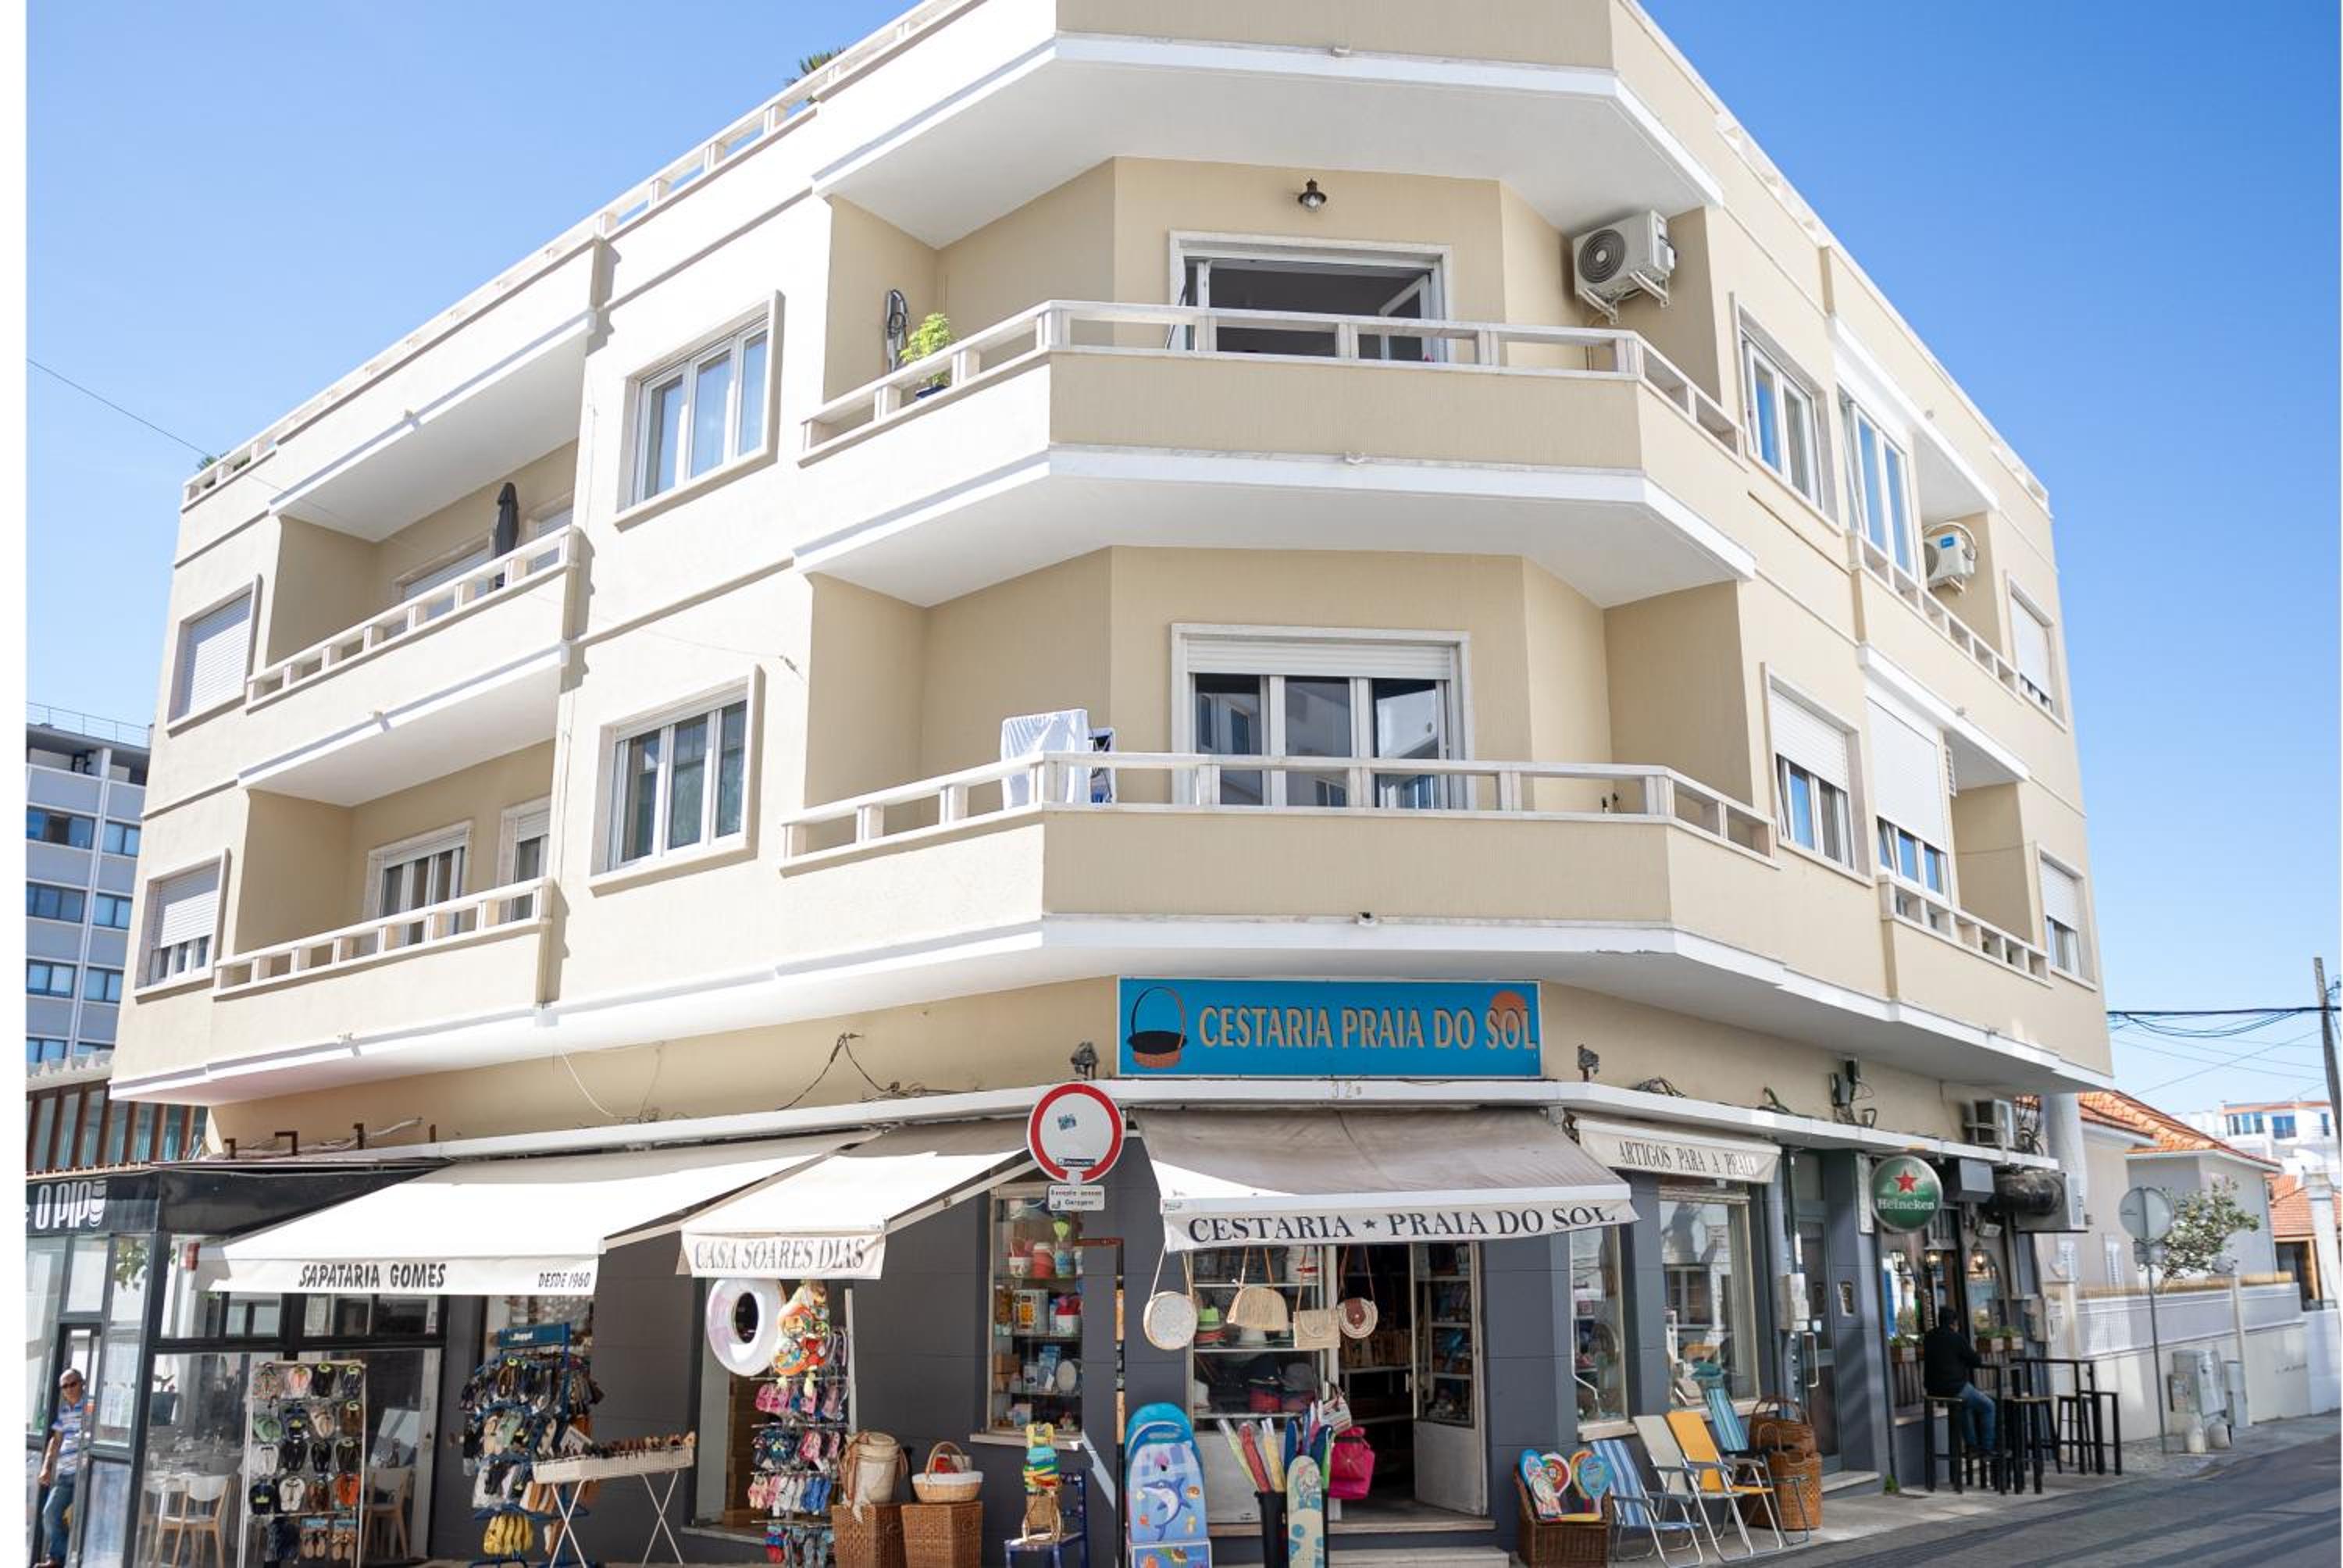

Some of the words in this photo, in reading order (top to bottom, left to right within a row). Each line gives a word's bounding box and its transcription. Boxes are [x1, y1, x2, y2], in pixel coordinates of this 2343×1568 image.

[1198, 1006, 1333, 1048] CESTARIA
[1341, 1007, 1425, 1049] PRAIA
[1433, 1008, 1476, 1049] DO
[1485, 1008, 1538, 1050] SOL
[1618, 1140, 1673, 1170] ARTIGOS
[1674, 1147, 1706, 1172] PARA
[1878, 1198, 1935, 1210] Heineken
[1188, 1215, 1355, 1242] CESTARIA
[1387, 1210, 1489, 1236] PRAIA
[1496, 1208, 1544, 1235] DO
[1552, 1206, 1616, 1231] SOL
[695, 1240, 737, 1270] CASA
[742, 1238, 814, 1270] SOARES
[818, 1238, 865, 1270] DIAS
[298, 1263, 380, 1289] SAPATARIA
[390, 1263, 446, 1289] GOMES
[538, 1272, 568, 1288] DESDE
[568, 1271, 591, 1288] 1960
